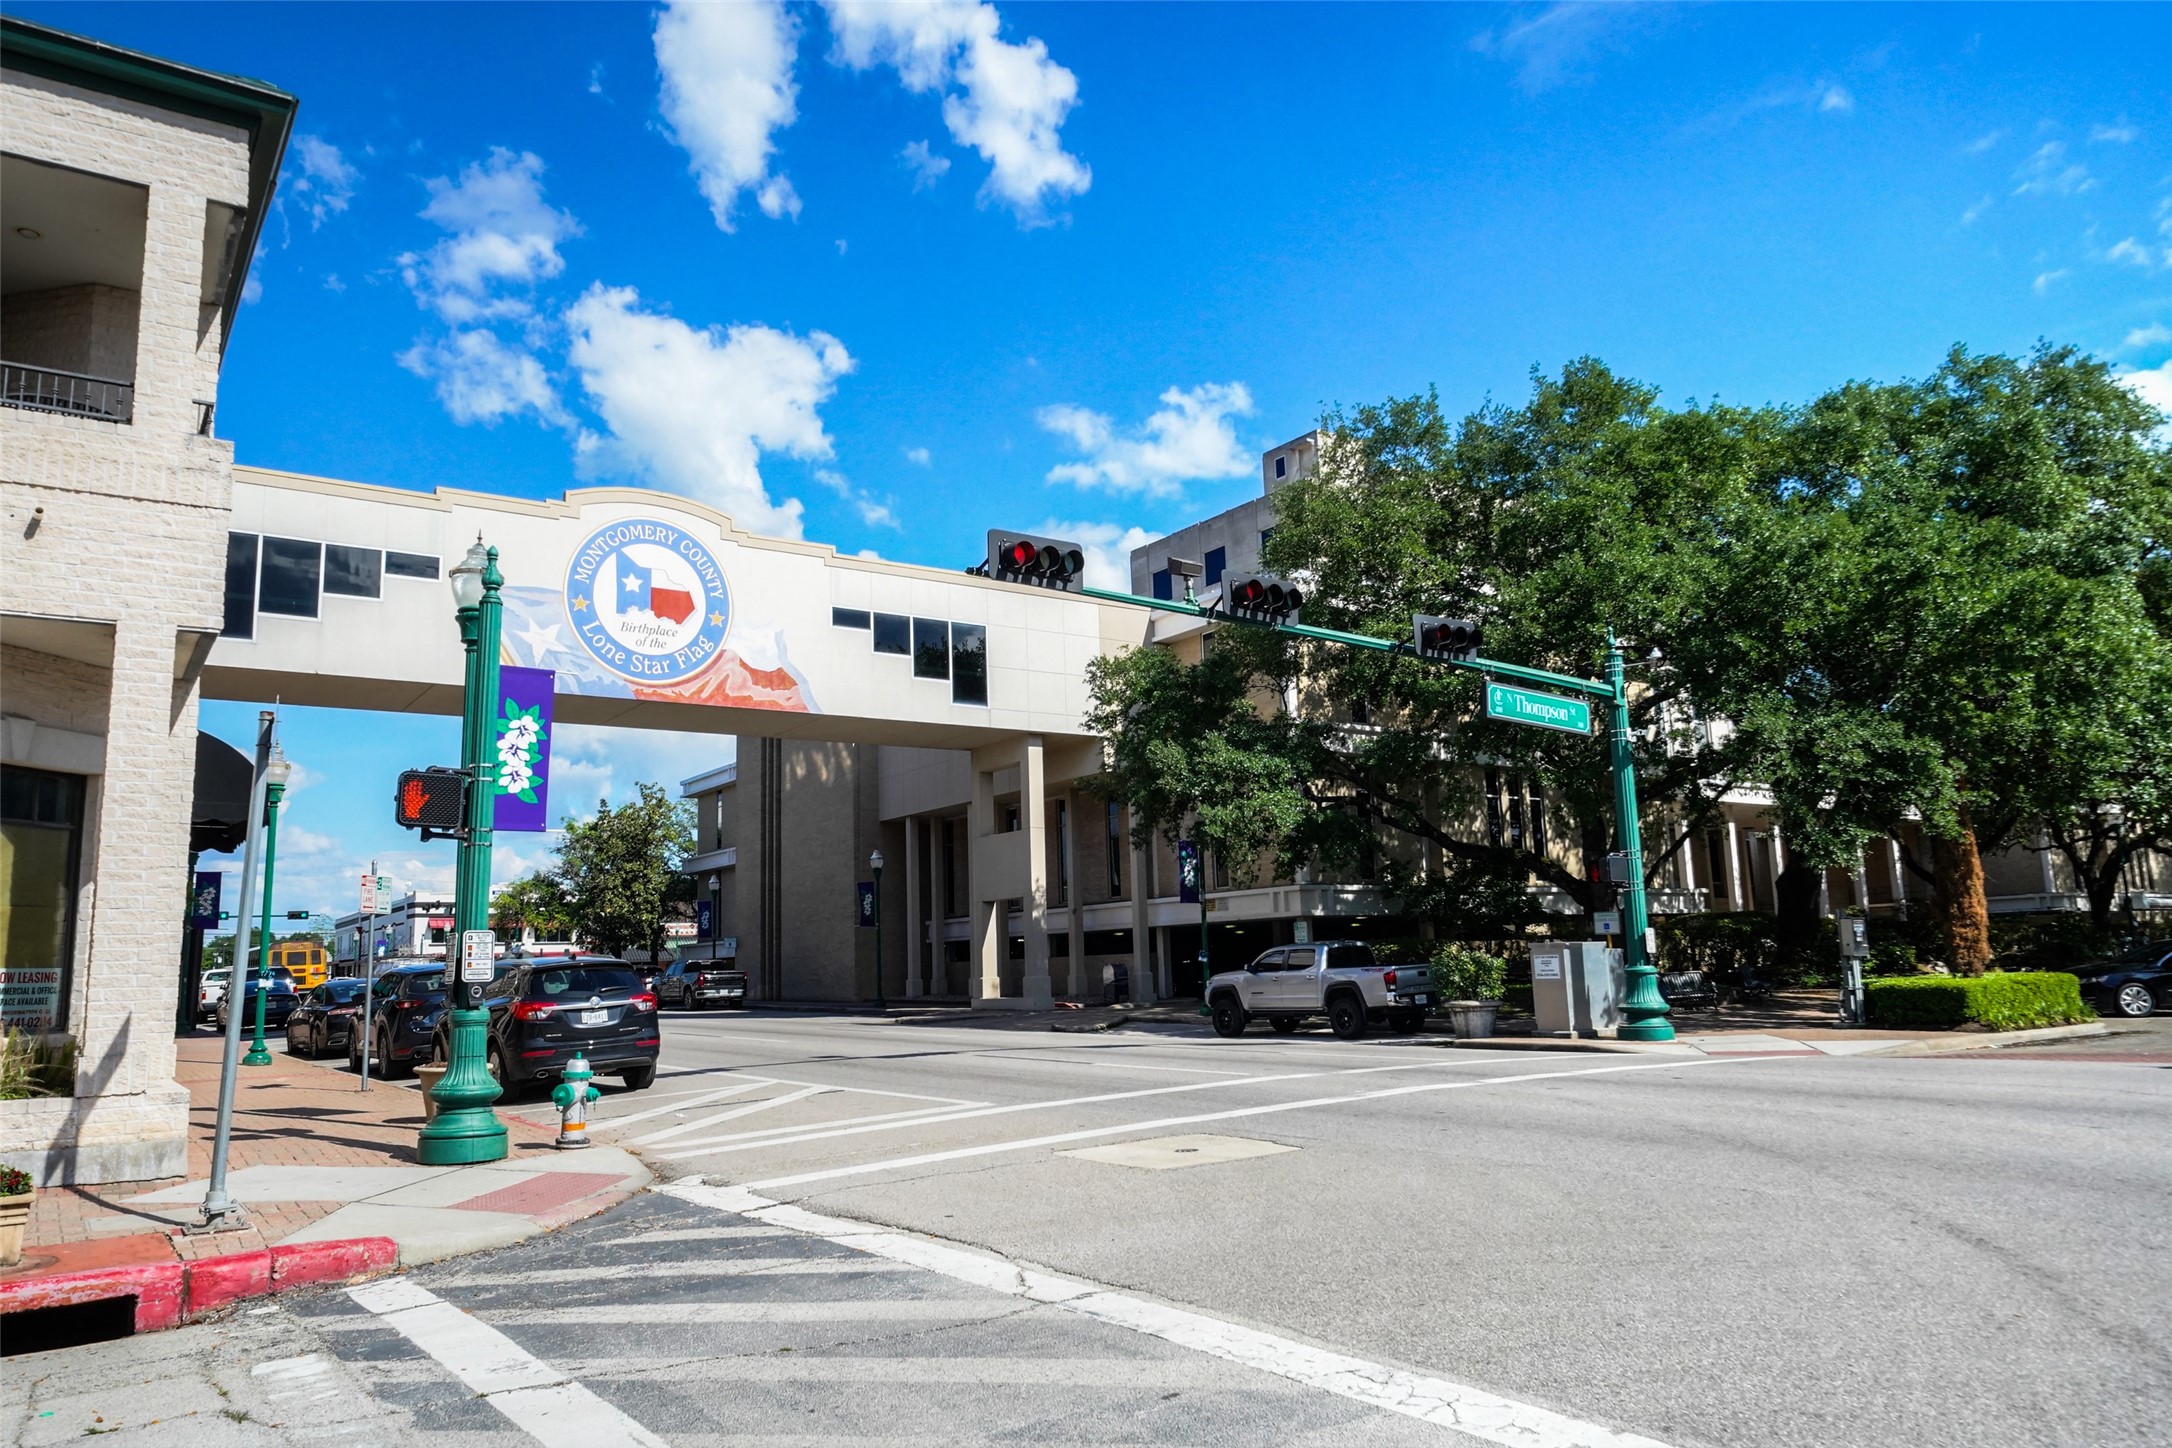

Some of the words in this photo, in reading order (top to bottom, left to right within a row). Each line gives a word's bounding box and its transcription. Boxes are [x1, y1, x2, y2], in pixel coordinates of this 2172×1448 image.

[574, 525, 678, 584] MONTGOMERY
[680, 540, 724, 599] COUNTY
[620, 621, 678, 638] Birthplace
[582, 620, 626, 665] Lone
[630, 654, 670, 674] Star
[674, 634, 715, 669] Flag
[635, 636, 648, 648] of
[650, 637, 667, 649] the
[1506, 692, 1513, 703] N
[1514, 694, 1568, 721] Thompson
[1569, 705, 1576, 716] St
[17, 972, 57, 983] LEASING
[17, 997, 48, 1005] AVAILABLE
